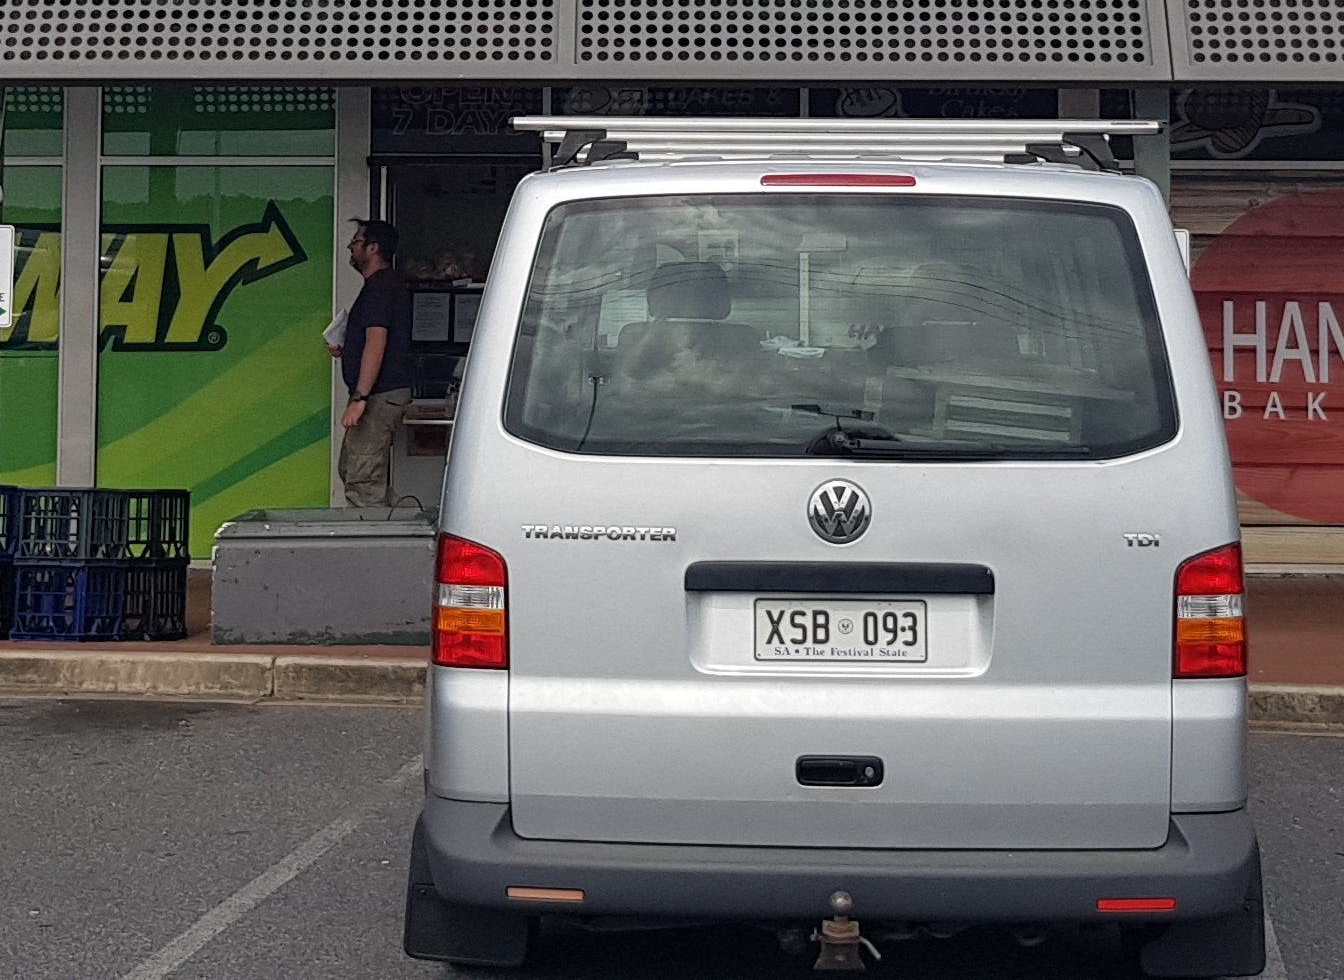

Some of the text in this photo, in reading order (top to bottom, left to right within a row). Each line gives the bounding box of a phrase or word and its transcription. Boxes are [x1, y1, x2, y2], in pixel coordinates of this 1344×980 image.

[392, 109, 413, 135] 7
[521, 524, 676, 541] TRANSPORTER
[1123, 533, 1160, 547] TDI
[765, 610, 917, 646] XSB 093
[774, 647, 909, 657] SA The Festival State
